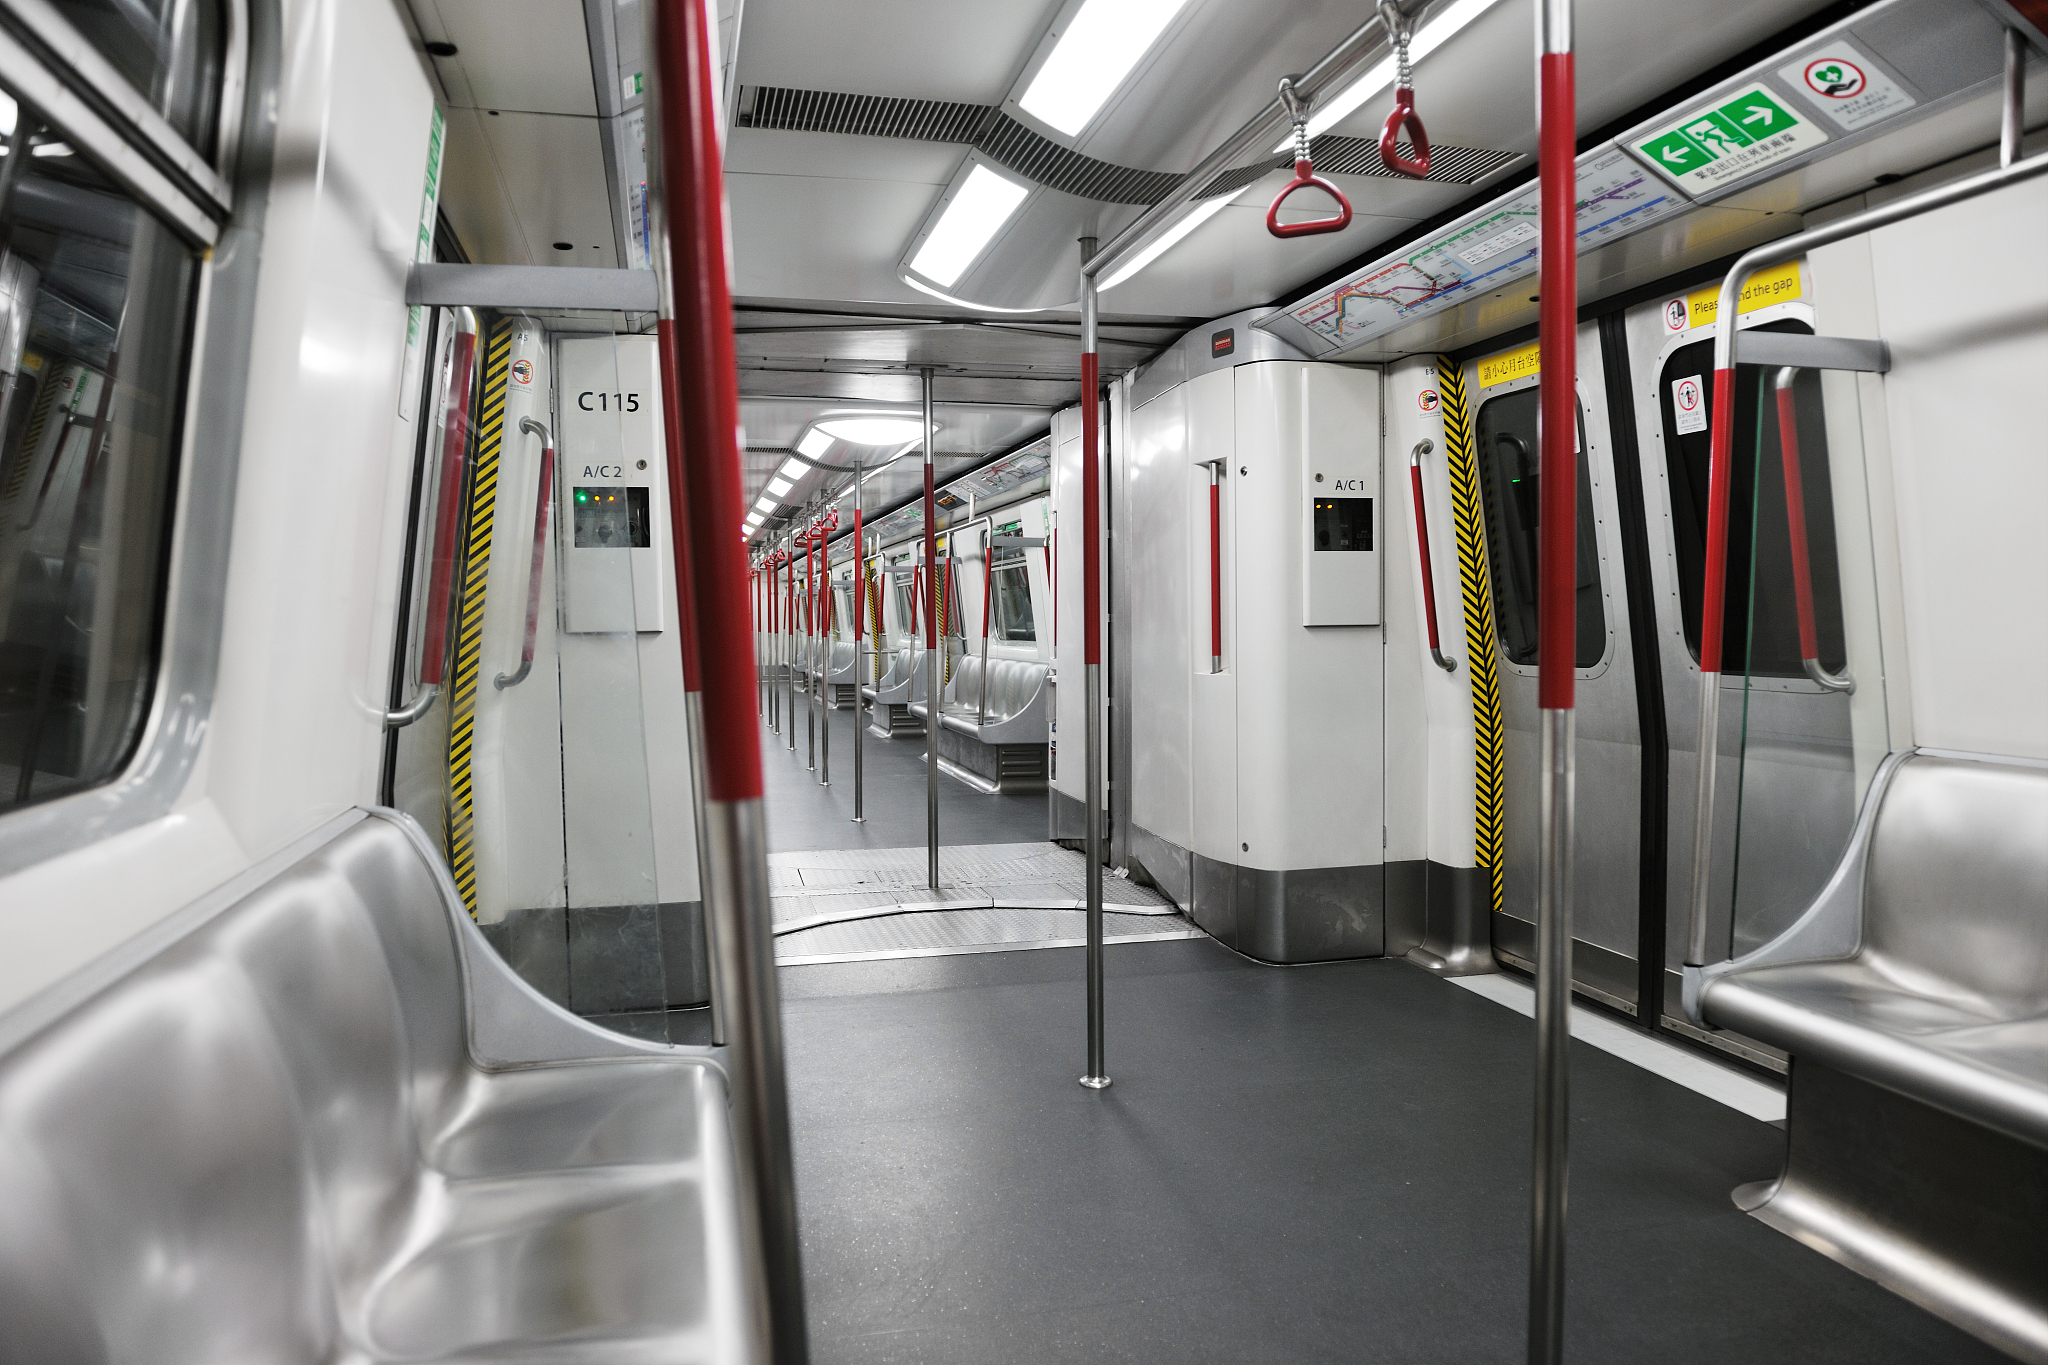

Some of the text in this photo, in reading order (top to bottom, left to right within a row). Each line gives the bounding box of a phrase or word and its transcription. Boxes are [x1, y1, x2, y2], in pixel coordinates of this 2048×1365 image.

[1694, 277, 1793, 315] Pleas nd the gap
[577, 391, 640, 413] C115
[583, 465, 622, 478] A/C 2
[1335, 479, 1364, 491] A/C 1
